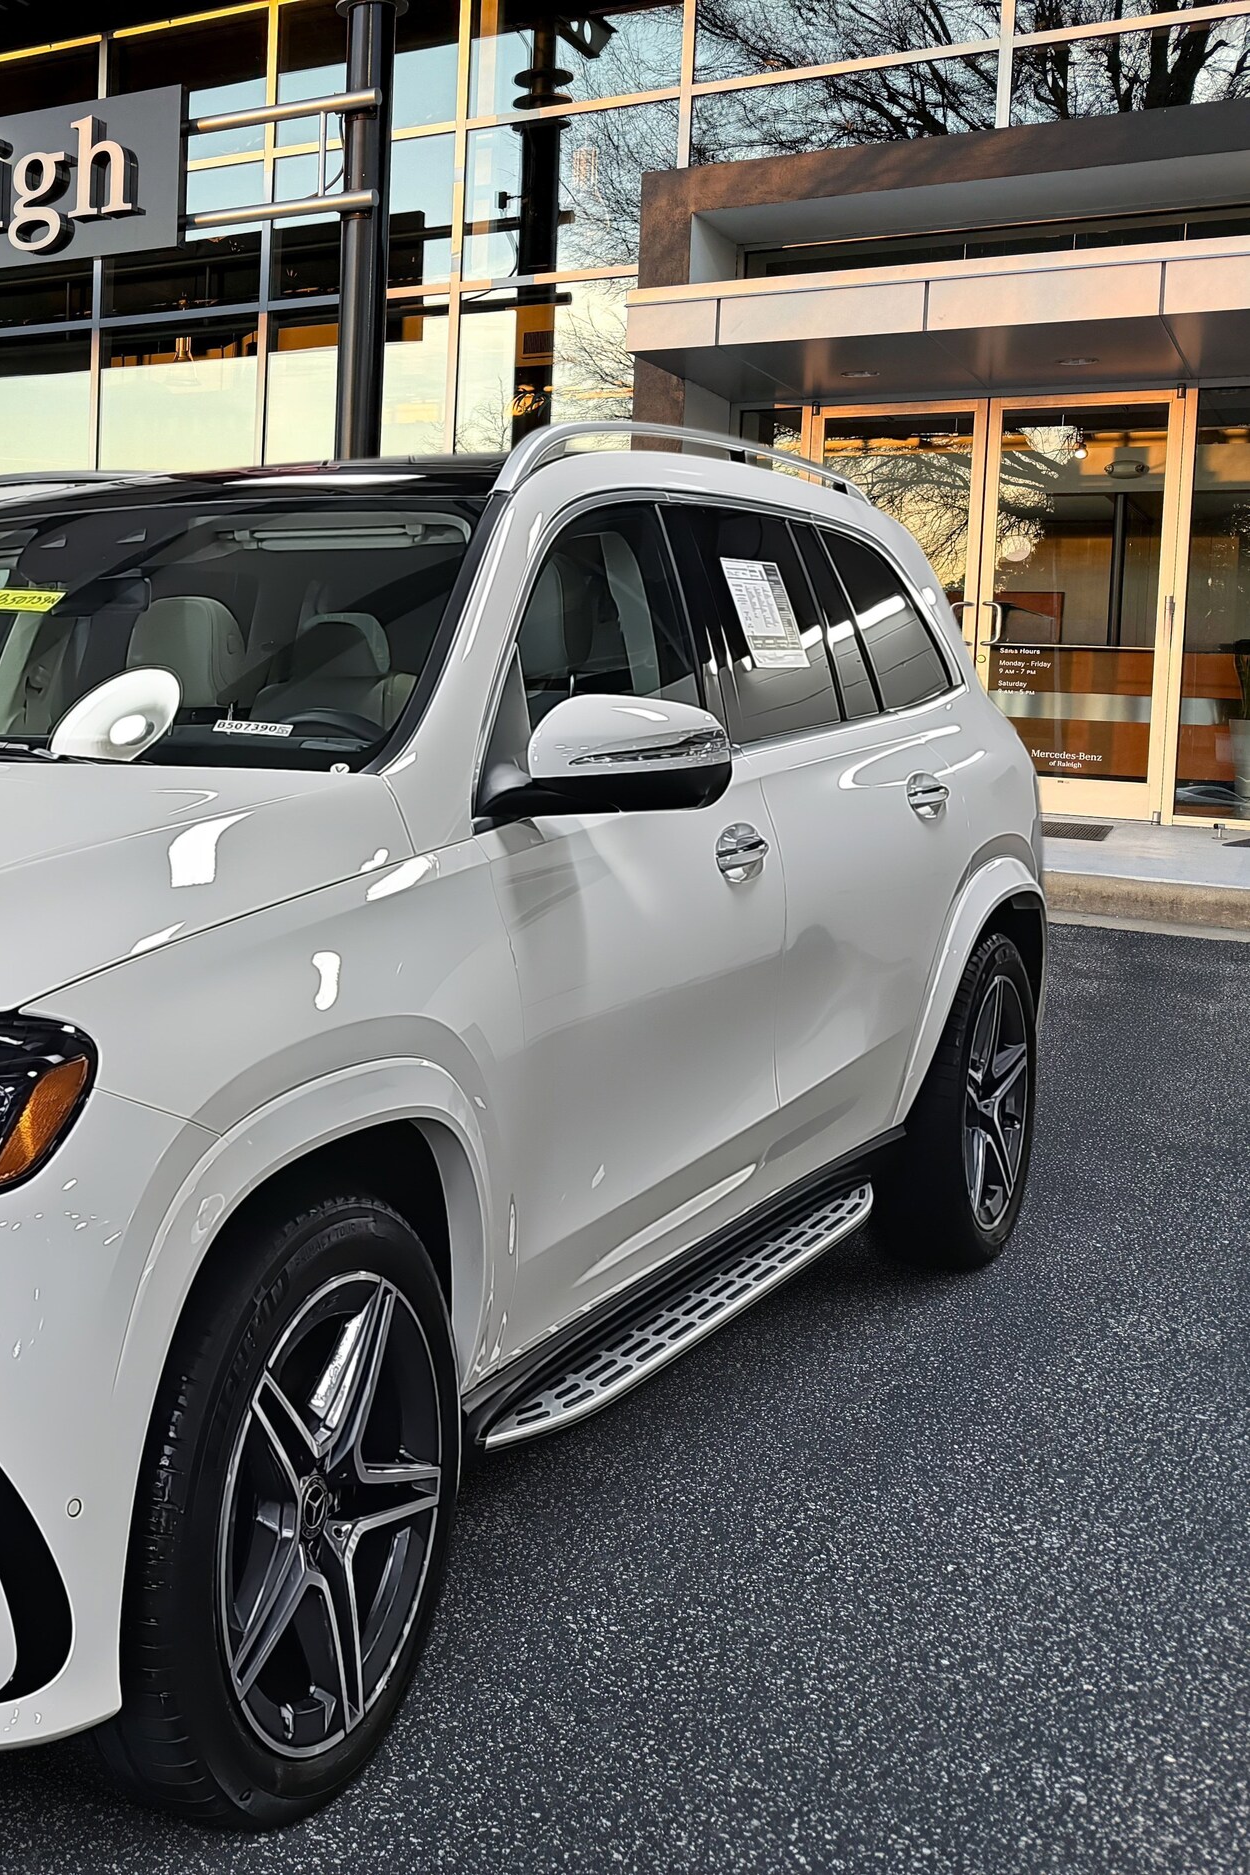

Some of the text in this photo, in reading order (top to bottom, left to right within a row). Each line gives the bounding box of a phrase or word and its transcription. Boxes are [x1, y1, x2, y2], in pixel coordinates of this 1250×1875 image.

[999, 660, 1025, 668] Monday
[998, 680, 1027, 688] Saturday
[217, 721, 277, 732] B507390
[1031, 749, 1103, 762] Mercedes-Benz
[1057, 761, 1082, 769] Raleigh
